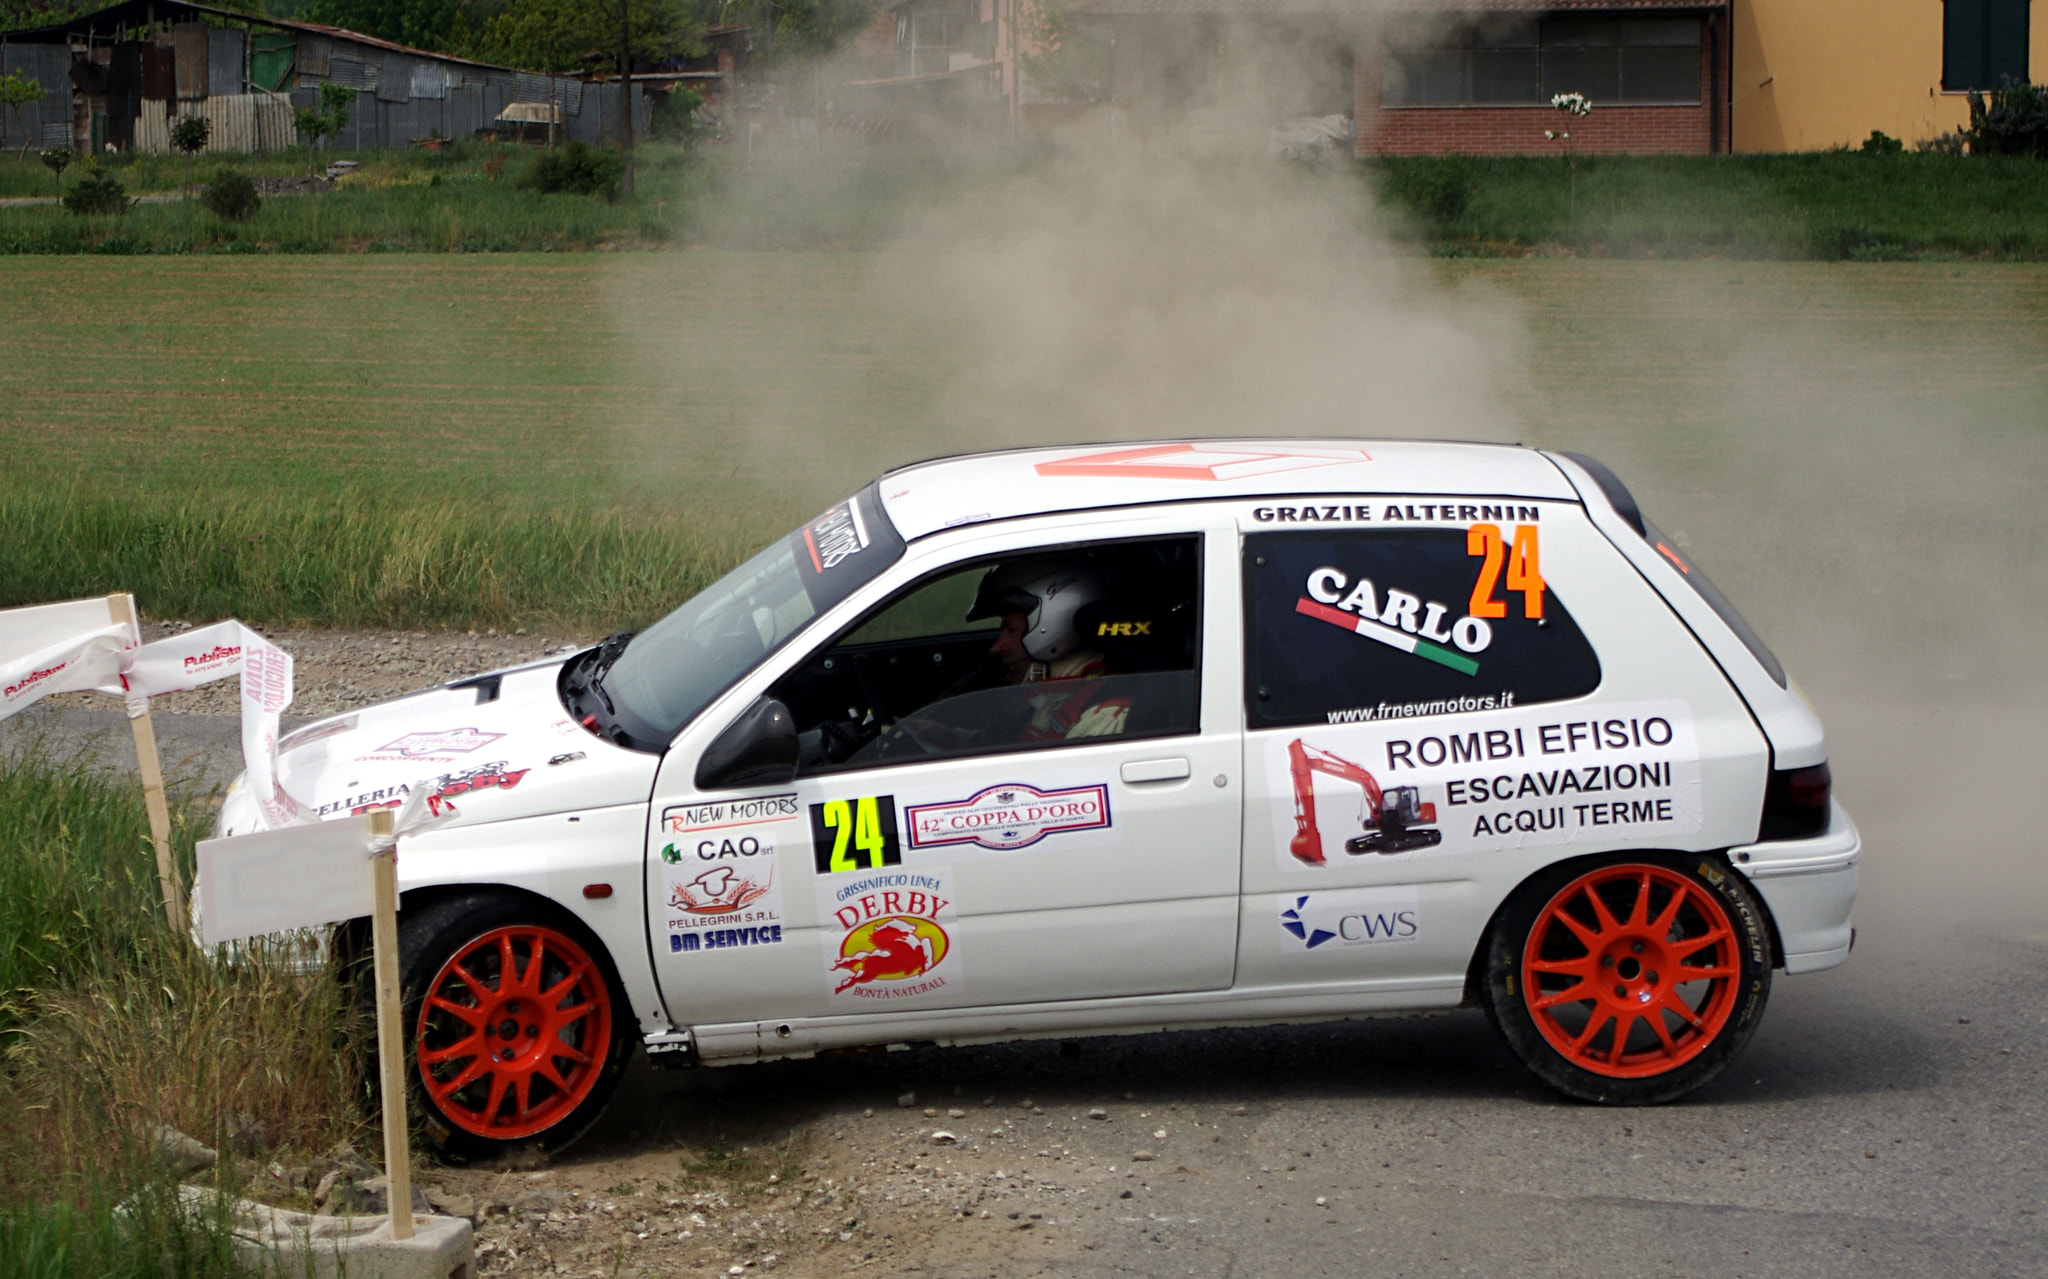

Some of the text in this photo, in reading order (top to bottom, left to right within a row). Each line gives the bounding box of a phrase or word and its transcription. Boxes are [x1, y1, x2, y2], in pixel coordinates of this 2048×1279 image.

[1252, 504, 1540, 523] GRAZIE ALTERNIN
[1466, 523, 1546, 620] 24
[1306, 567, 1492, 654] CARLO
[1097, 621, 1151, 636] HRX
[1326, 691, 1514, 725] www.frnewmotors.it
[1385, 716, 1673, 772] ROMBI EFISIO
[1445, 761, 1672, 807] ESCAVAZIONI
[312, 783, 411, 817] ELLERIA
[685, 806, 724, 826] NEW
[730, 796, 799, 820] MOTORS
[950, 811, 1022, 830] COPPA
[1472, 798, 1674, 838] ACQUI TERME
[697, 836, 760, 861] CAO
[823, 795, 886, 874] 24
[836, 874, 941, 902] GRISSINIFICIO LINEA
[669, 911, 779, 930] PELLEGRINI S.R.L.
[833, 890, 949, 931] DERBY
[703, 924, 783, 950] SERVICE
[1338, 911, 1418, 941] CWS
[853, 977, 946, 999] BONTÀ NATURALI
